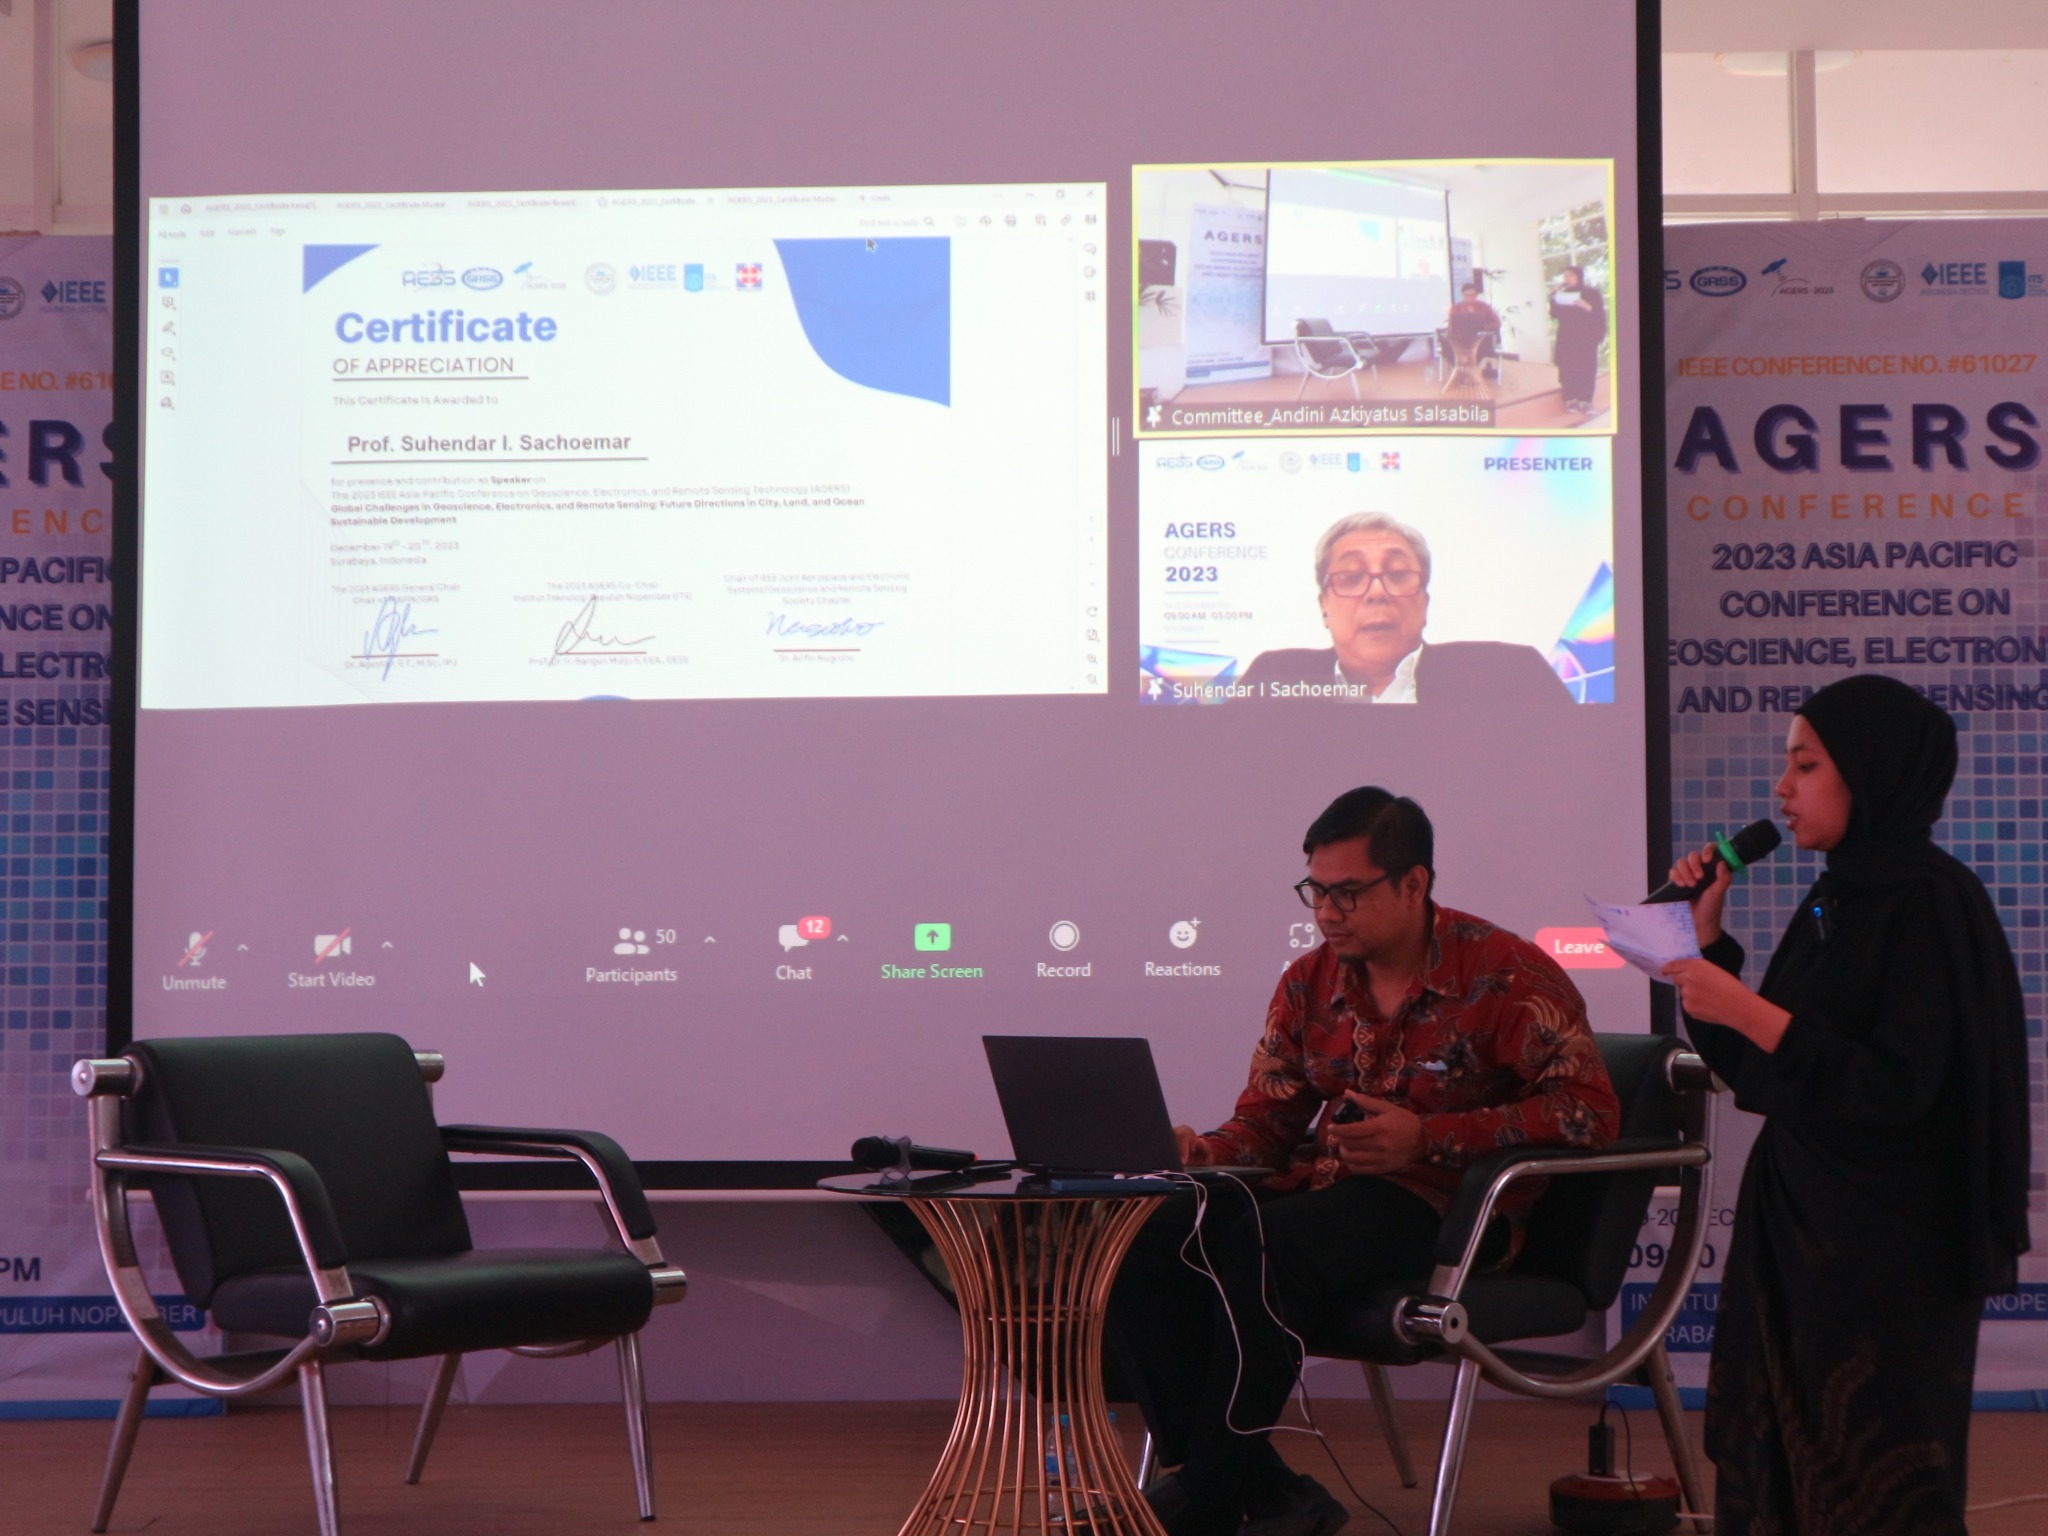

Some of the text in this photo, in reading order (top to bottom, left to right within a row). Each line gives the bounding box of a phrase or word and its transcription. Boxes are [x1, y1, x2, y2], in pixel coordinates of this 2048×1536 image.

[641, 264, 677, 281] IEEE
[1697, 275, 1739, 287] GRSS
[1940, 263, 1987, 285] IEEE
[58, 281, 106, 303] IEEE
[334, 309, 558, 343] Certificate
[333, 356, 514, 375] OF APPRECIATION
[1678, 354, 2037, 377] IEEE CONFERENCE NO. #61027
[19, 370, 60, 391] NO.
[333, 395, 356, 406] This
[358, 394, 419, 406] Certificate
[433, 394, 483, 405] Awarded
[486, 395, 498, 405] to
[1172, 403, 1490, 427] Committee_Andini Azkiyatus Salsabila
[347, 435, 394, 453] Prof.
[400, 434, 496, 452] Suhendar
[520, 433, 632, 451] Sachoemar
[1674, 402, 2041, 475] AGERS
[1483, 456, 1593, 472] PRESENTER
[491, 474, 531, 487] Speaker
[331, 502, 363, 514] Global
[365, 502, 420, 515] Challenges
[422, 502, 431, 512] in
[556, 500, 574, 511] and
[576, 499, 615, 511] Remote
[660, 498, 692, 509] Future
[694, 498, 745, 508] Directions
[748, 498, 757, 508] in
[813, 497, 831, 507] and
[833, 496, 865, 507] Ocean
[1687, 492, 2025, 522] CONFERENCE
[330, 515, 457, 528] Sustainable Development
[1164, 522, 1236, 539] AGERS
[1163, 546, 1267, 560] CONFERENCE
[1712, 540, 2019, 571] 2023 ASIA PACIFIC
[1165, 566, 1219, 583] 2023
[1719, 588, 2011, 618] CONFERENCE ON
[1173, 682, 1254, 698] Suhendar
[1270, 681, 1367, 697] Sachoemar
[1677, 686, 1753, 714] AND
[804, 919, 824, 934] 12
[655, 929, 677, 944] 50
[1554, 938, 1605, 954] Leave
[586, 966, 678, 985] Participants
[775, 965, 813, 981] Chat
[881, 964, 983, 980] Share Screen
[1036, 962, 1092, 978] Record
[1145, 961, 1221, 977] Reactions
[162, 975, 227, 991] Unmute
[288, 972, 375, 988] Start Video
[0, 1305, 65, 1325] ULUH
